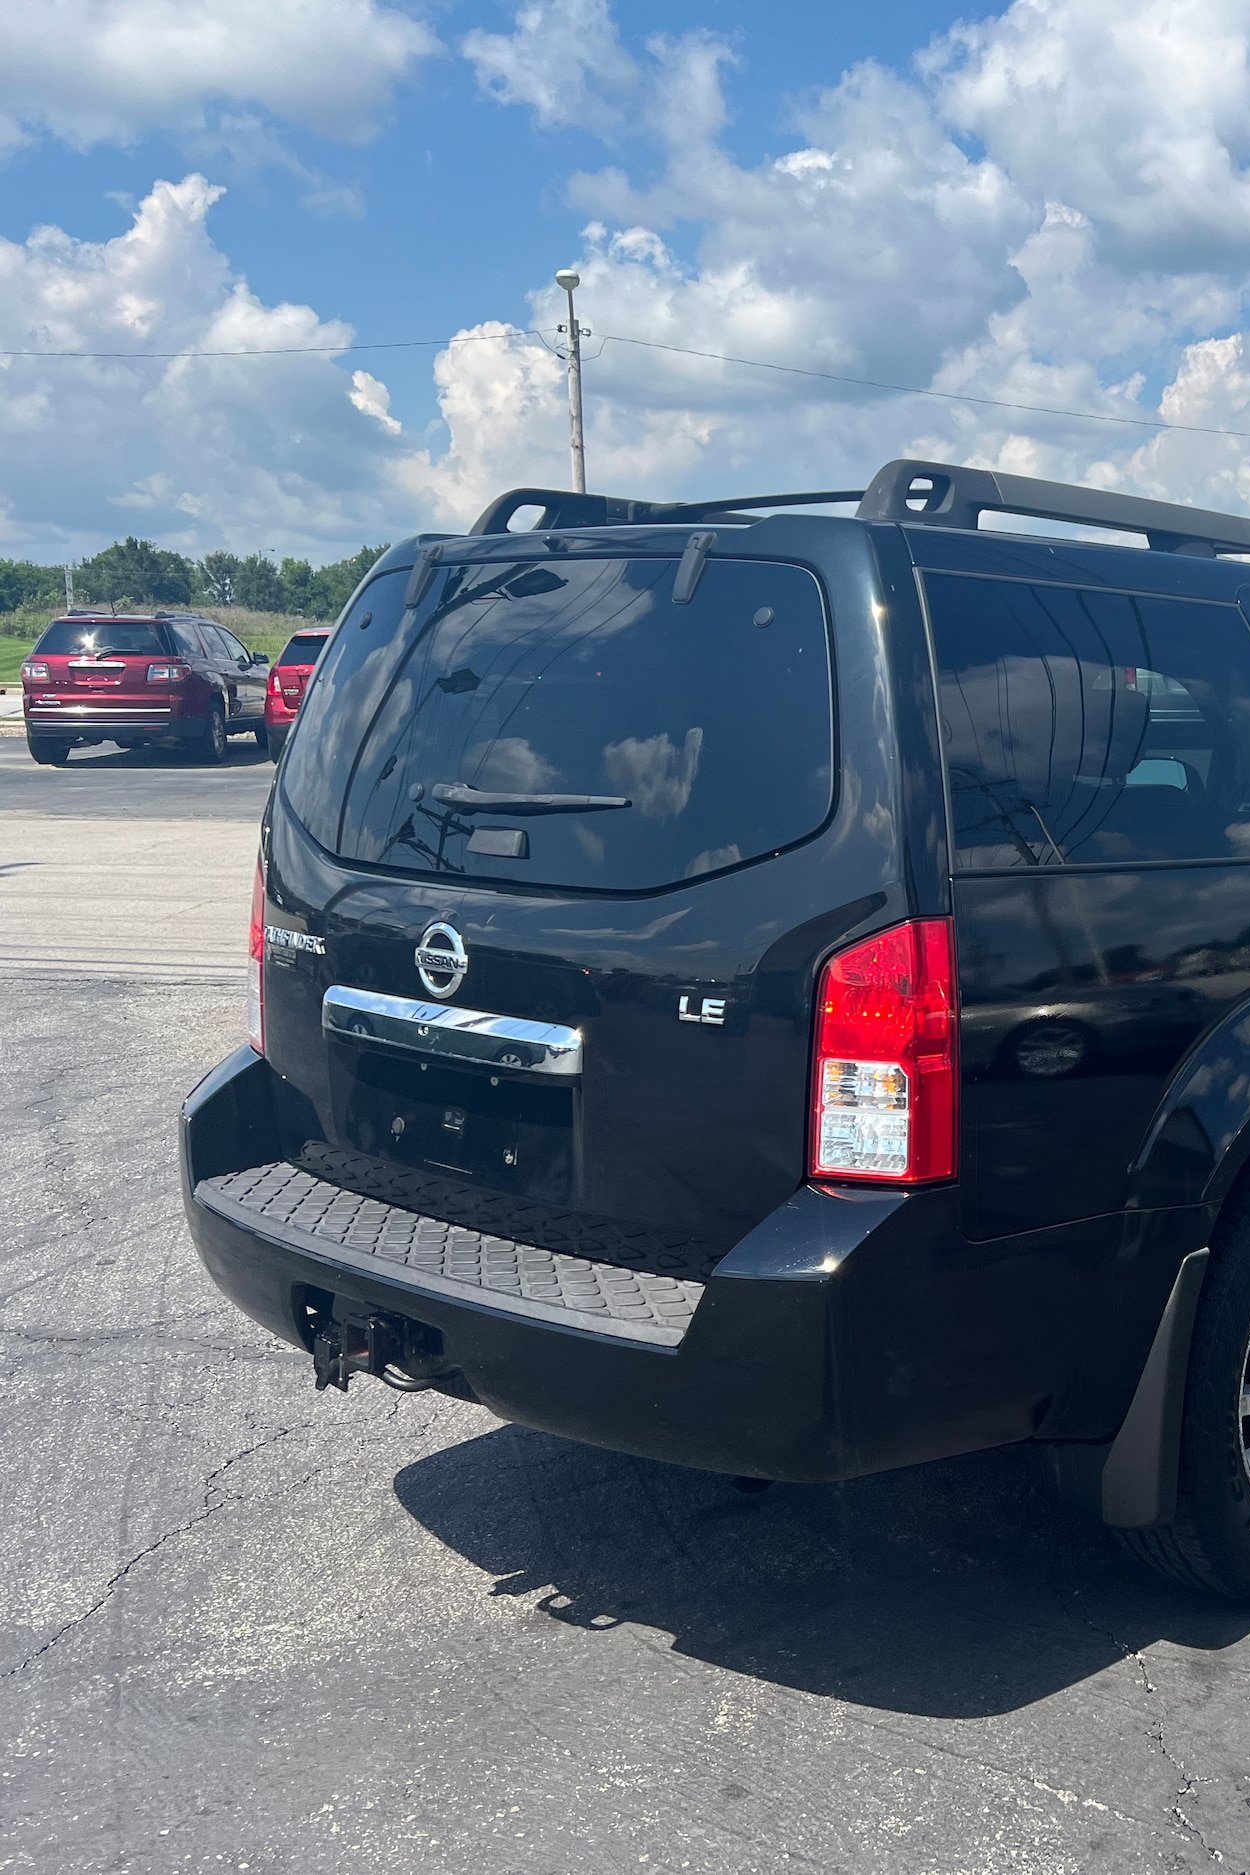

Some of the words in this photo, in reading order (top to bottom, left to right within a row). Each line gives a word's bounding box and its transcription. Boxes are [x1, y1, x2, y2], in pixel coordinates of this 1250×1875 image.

[264, 925, 326, 954] ATHFINDER
[416, 948, 459, 969] NISSAN
[679, 995, 726, 1025] LE
